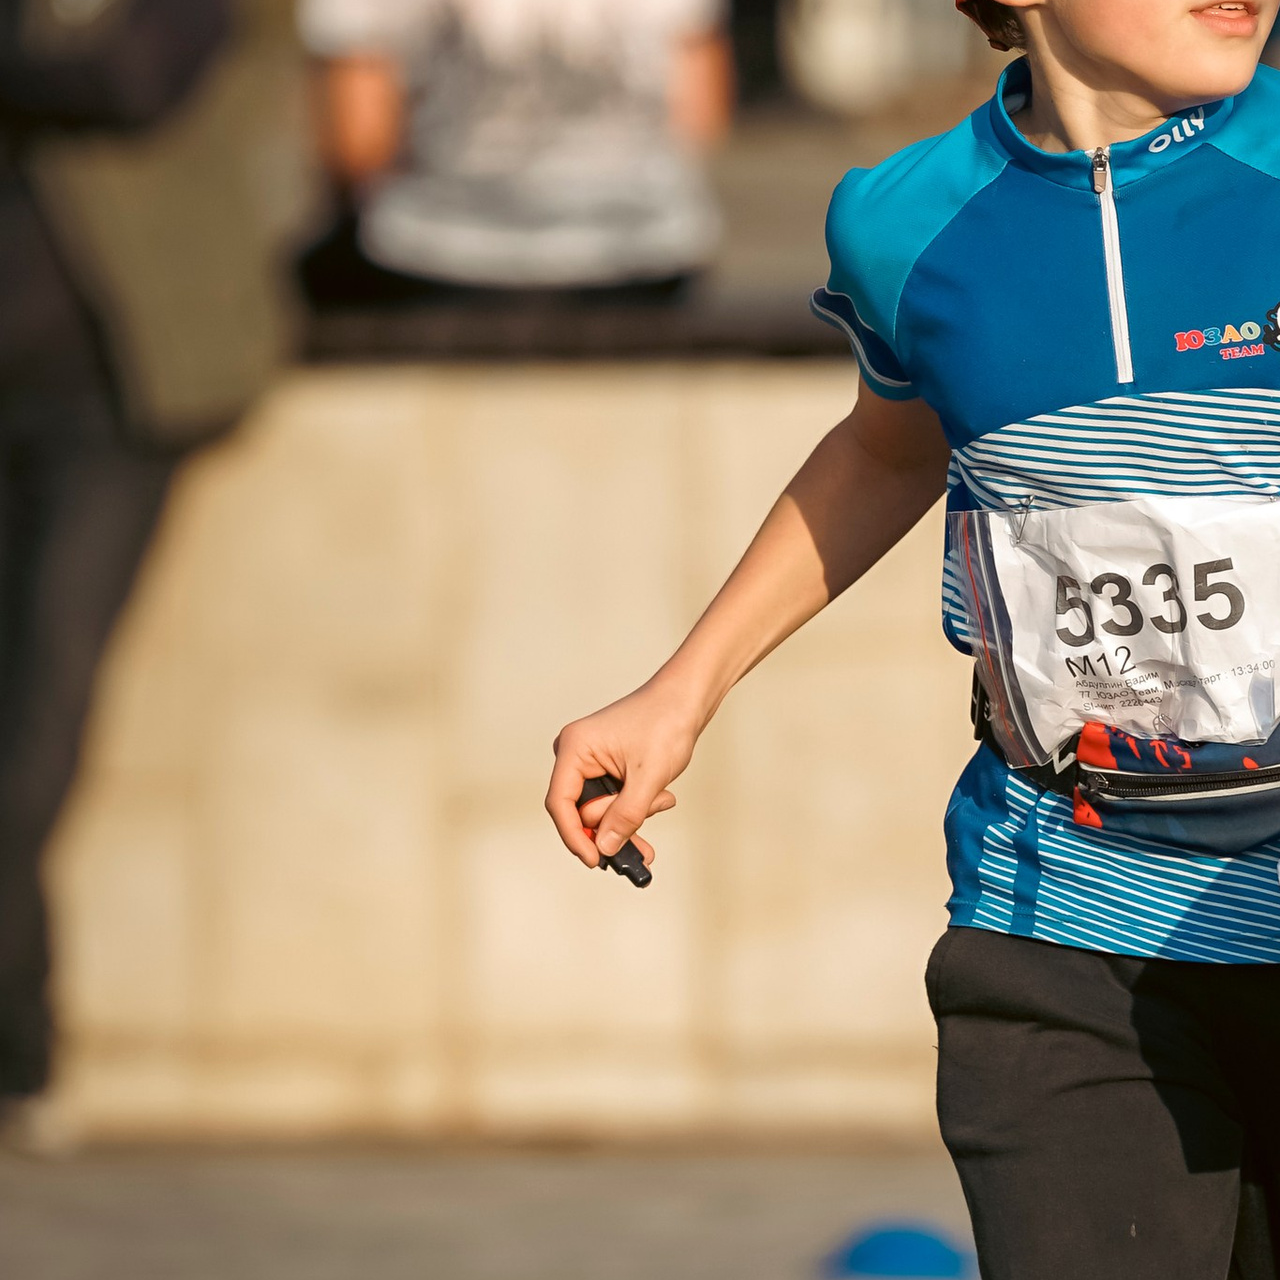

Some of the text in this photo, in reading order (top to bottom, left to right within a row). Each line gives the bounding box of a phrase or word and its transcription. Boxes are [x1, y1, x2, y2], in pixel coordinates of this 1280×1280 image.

[1148, 106, 1205, 153] OLLY
[1174, 321, 1262, 352] ЮЗАО
[1219, 343, 1265, 360] TEAM
[1056, 557, 1245, 647] 5335
[1231, 660, 1275, 676] 13:34:00
